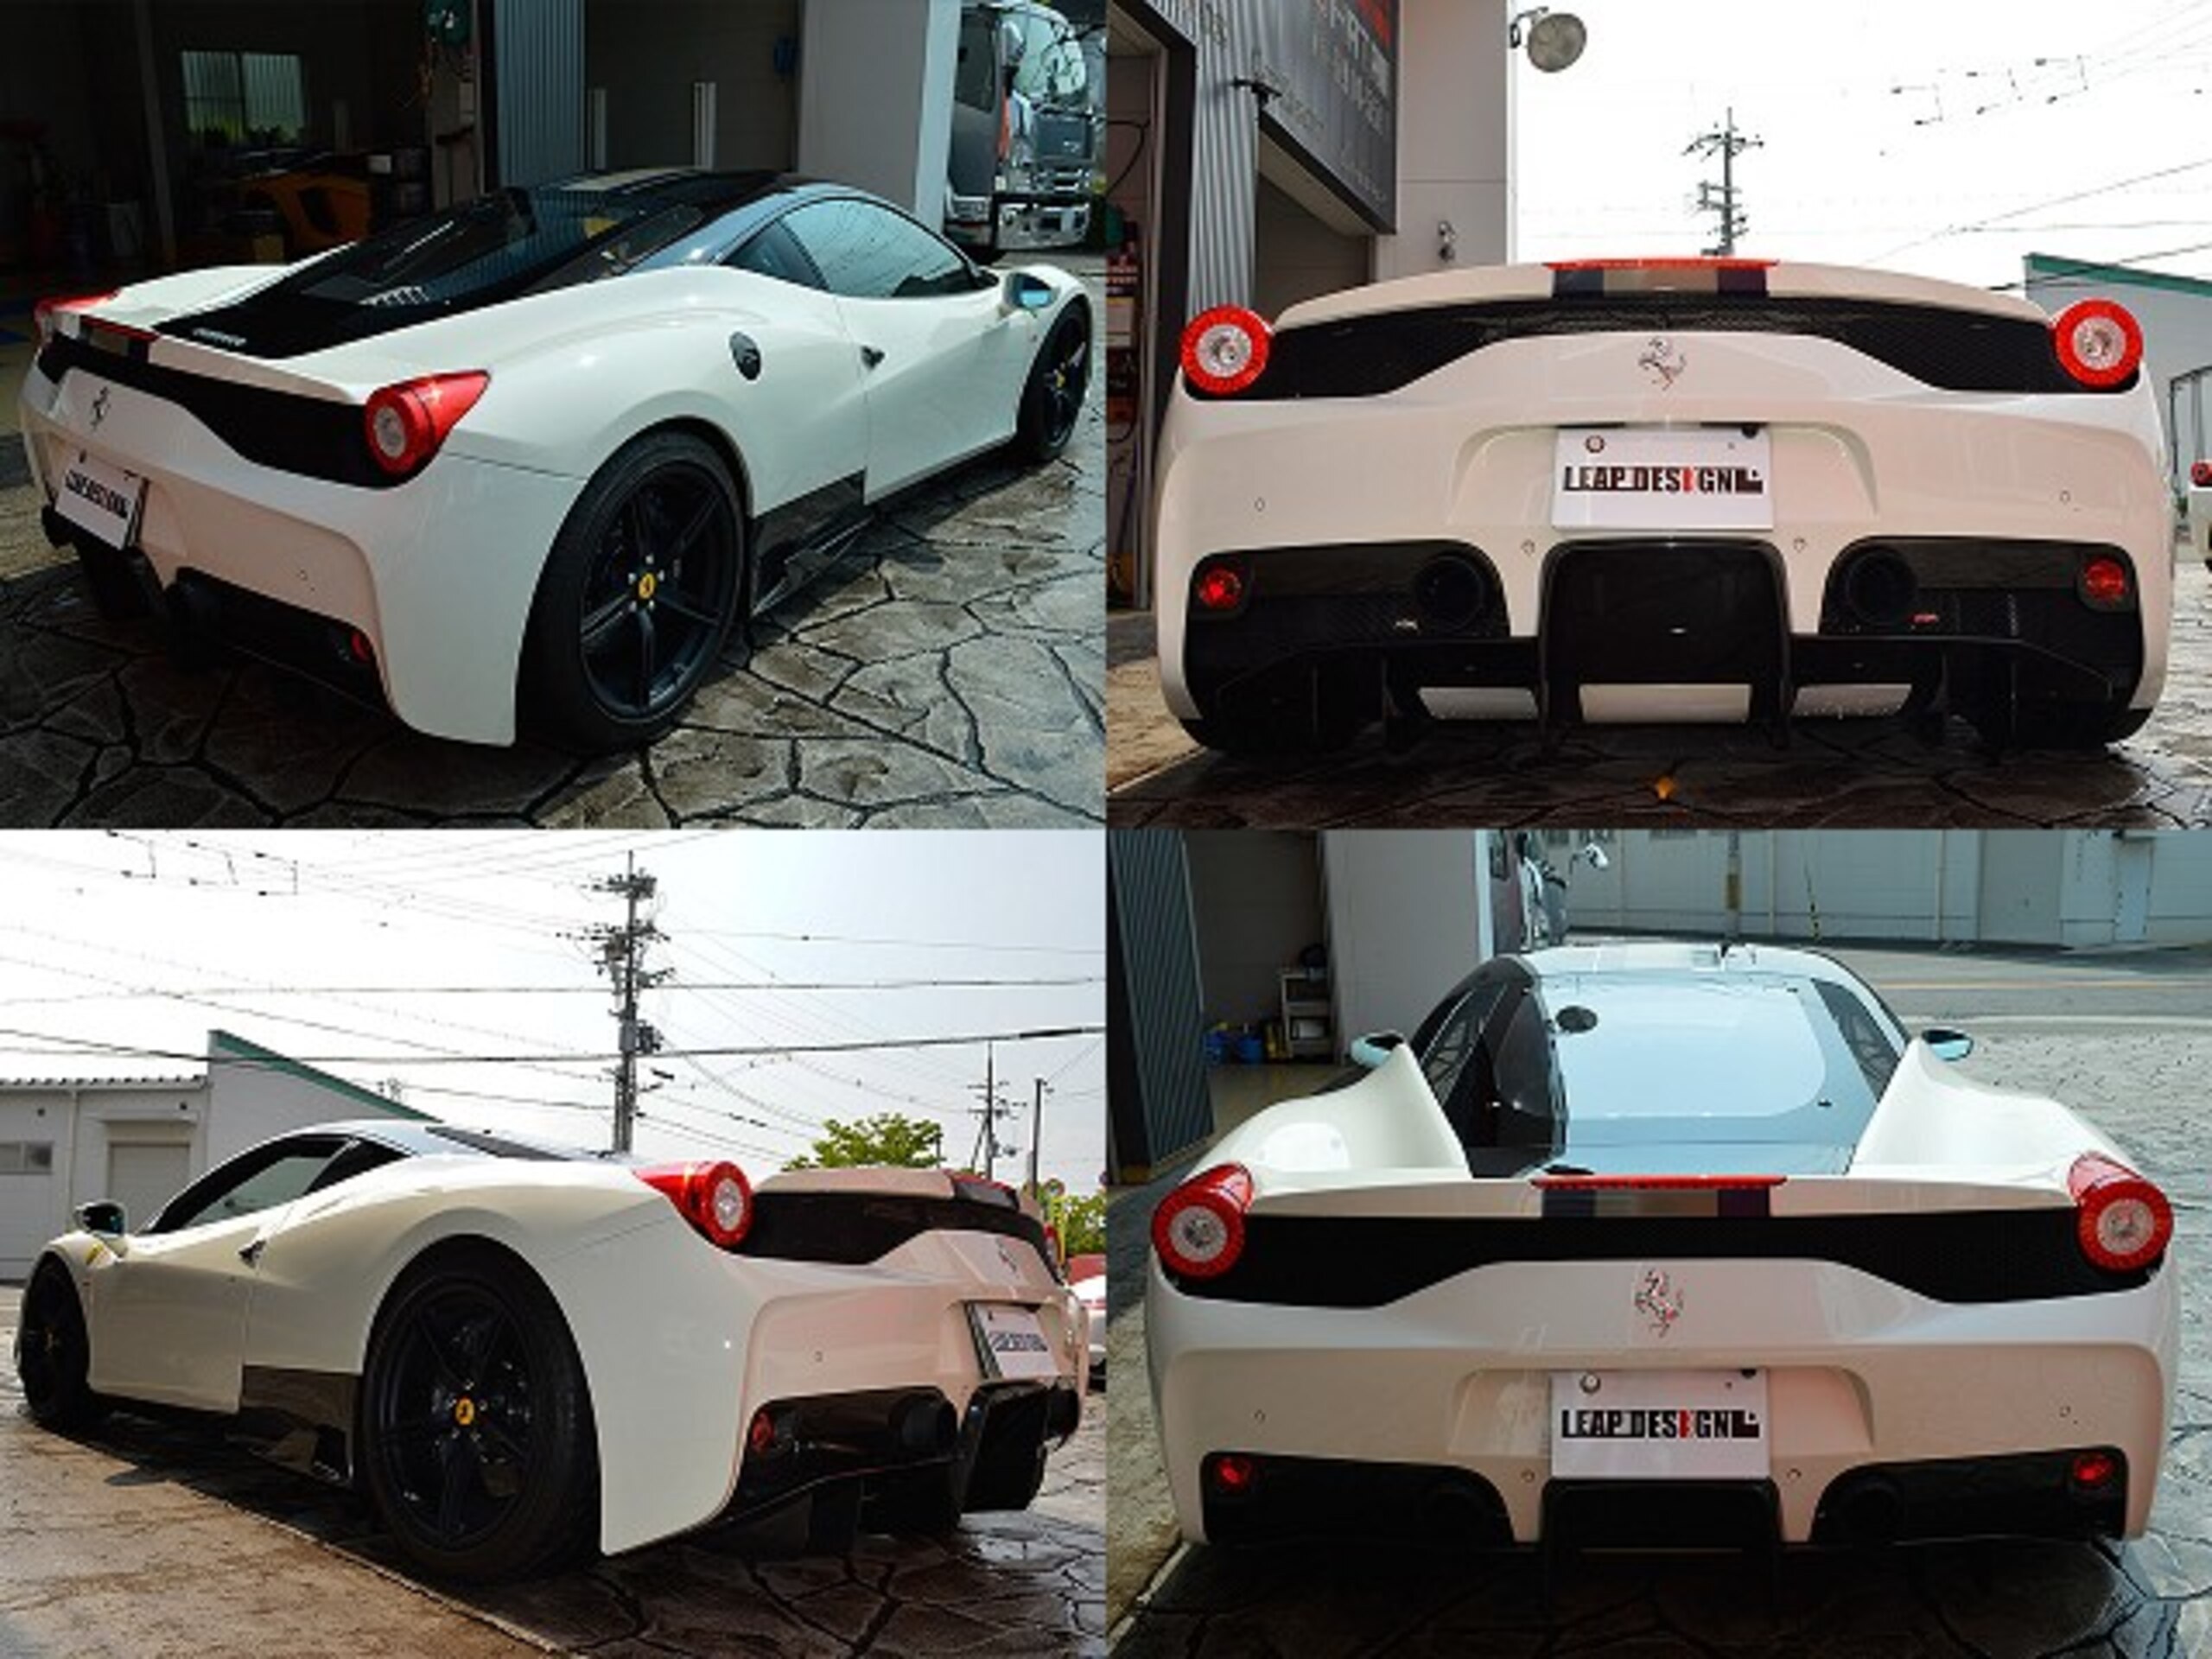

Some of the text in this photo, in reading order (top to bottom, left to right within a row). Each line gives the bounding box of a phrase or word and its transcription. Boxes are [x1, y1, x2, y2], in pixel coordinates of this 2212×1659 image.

[1563, 466, 1732, 493] LEAP DESIGN
[1561, 1409, 1729, 1439] LEAP DESIGN
